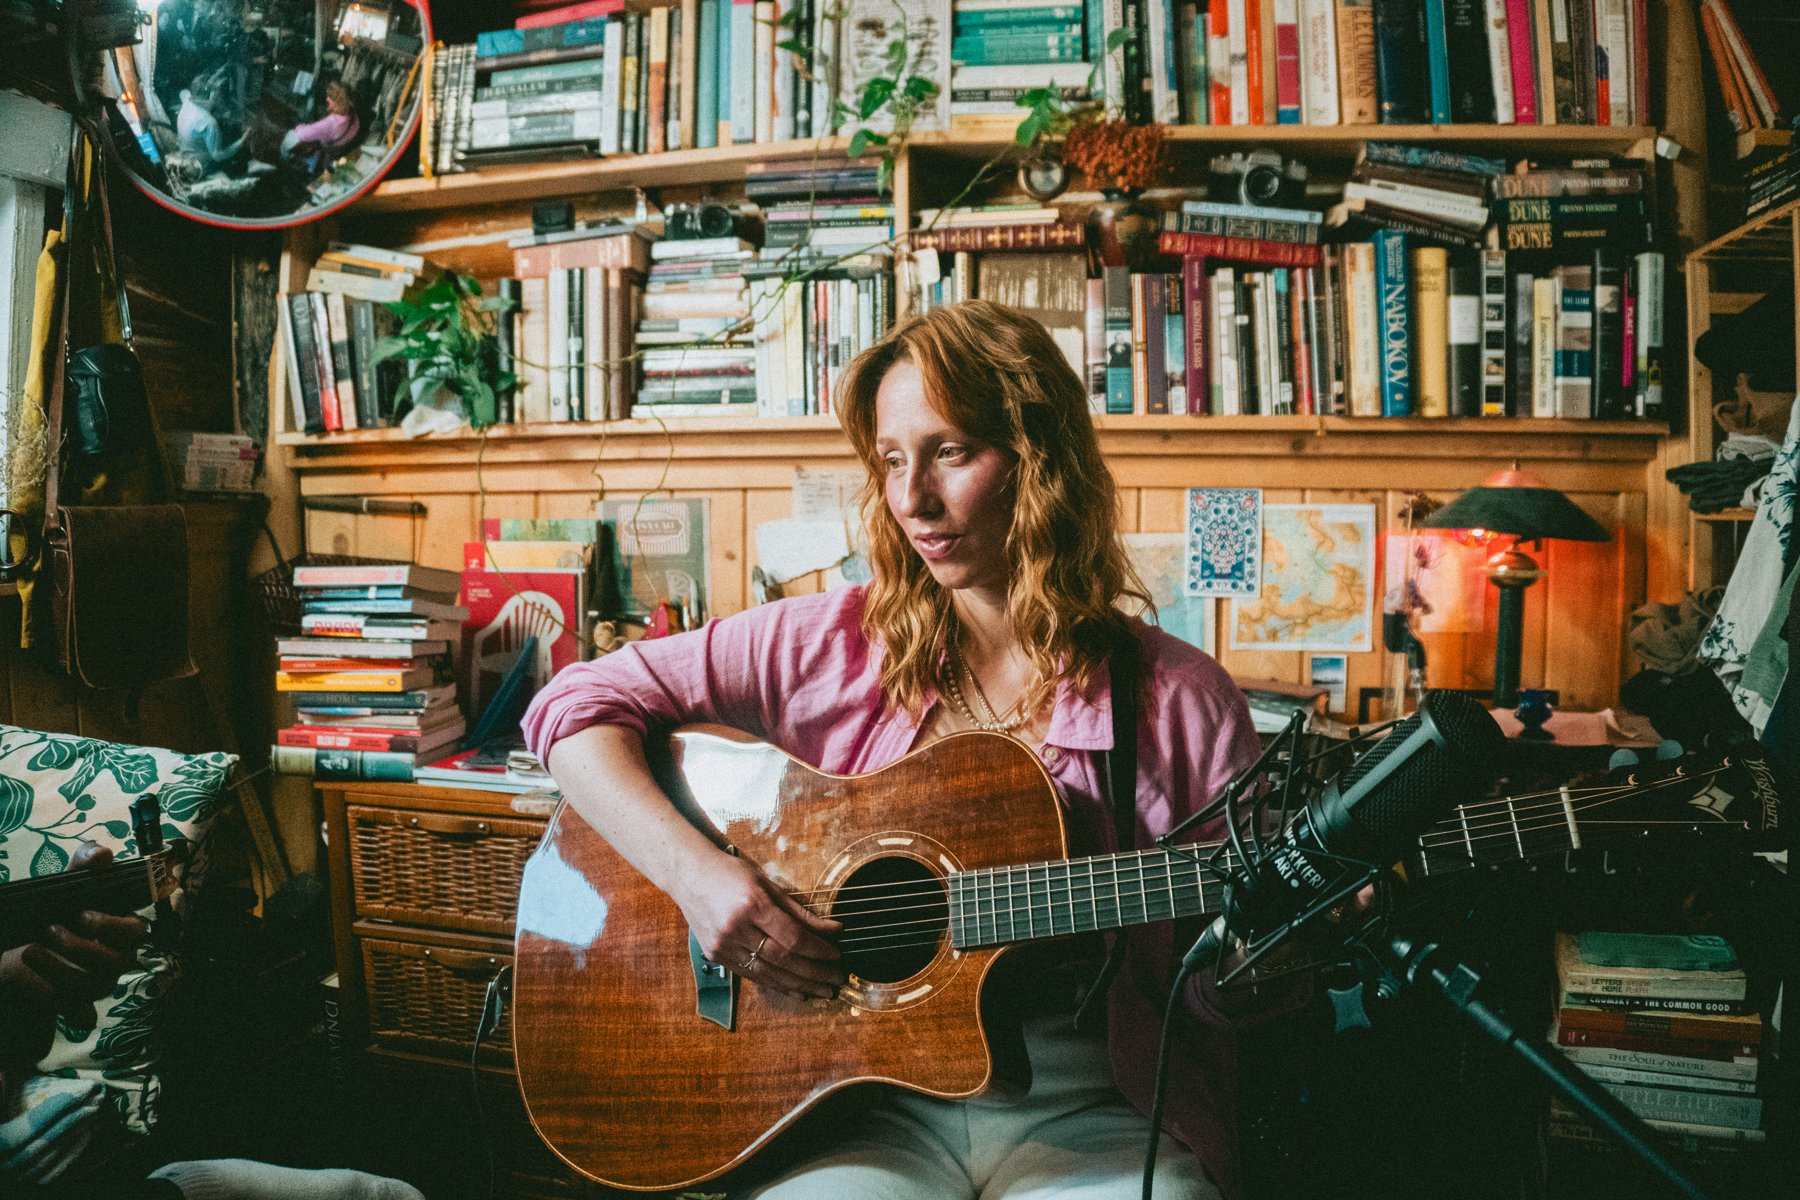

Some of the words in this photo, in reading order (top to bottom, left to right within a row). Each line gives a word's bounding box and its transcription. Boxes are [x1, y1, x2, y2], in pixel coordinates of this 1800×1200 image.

[484, 82, 547, 98] JERUSALEM
[1503, 175, 1550, 198] DUNE
[1561, 178, 1589, 189] FRANK
[1590, 178, 1629, 188] HERBERT
[1510, 204, 1551, 221] DUNE
[1560, 204, 1584, 213] FRANK
[1585, 203, 1617, 212] HERBERT
[1508, 230, 1552, 250] DUNE
[1193, 300, 1203, 341] ESSENTIAL
[1385, 283, 1409, 388] NABOKOV
[1193, 342, 1203, 369] ESSAYS
[1742, 758, 1780, 830] Washburn
[1274, 856, 1296, 880] ART
[1591, 978, 1622, 986] LETTERS
[1601, 985, 1622, 993] HOME
[1645, 999, 1660, 1008] THE
[1663, 1001, 1702, 1010] COMMON
[1705, 1003, 1730, 1012] GOOD
[1608, 1053, 1626, 1062] THE
[1629, 1051, 1658, 1066] SOUL
[1667, 1060, 1706, 1071] NATURE
